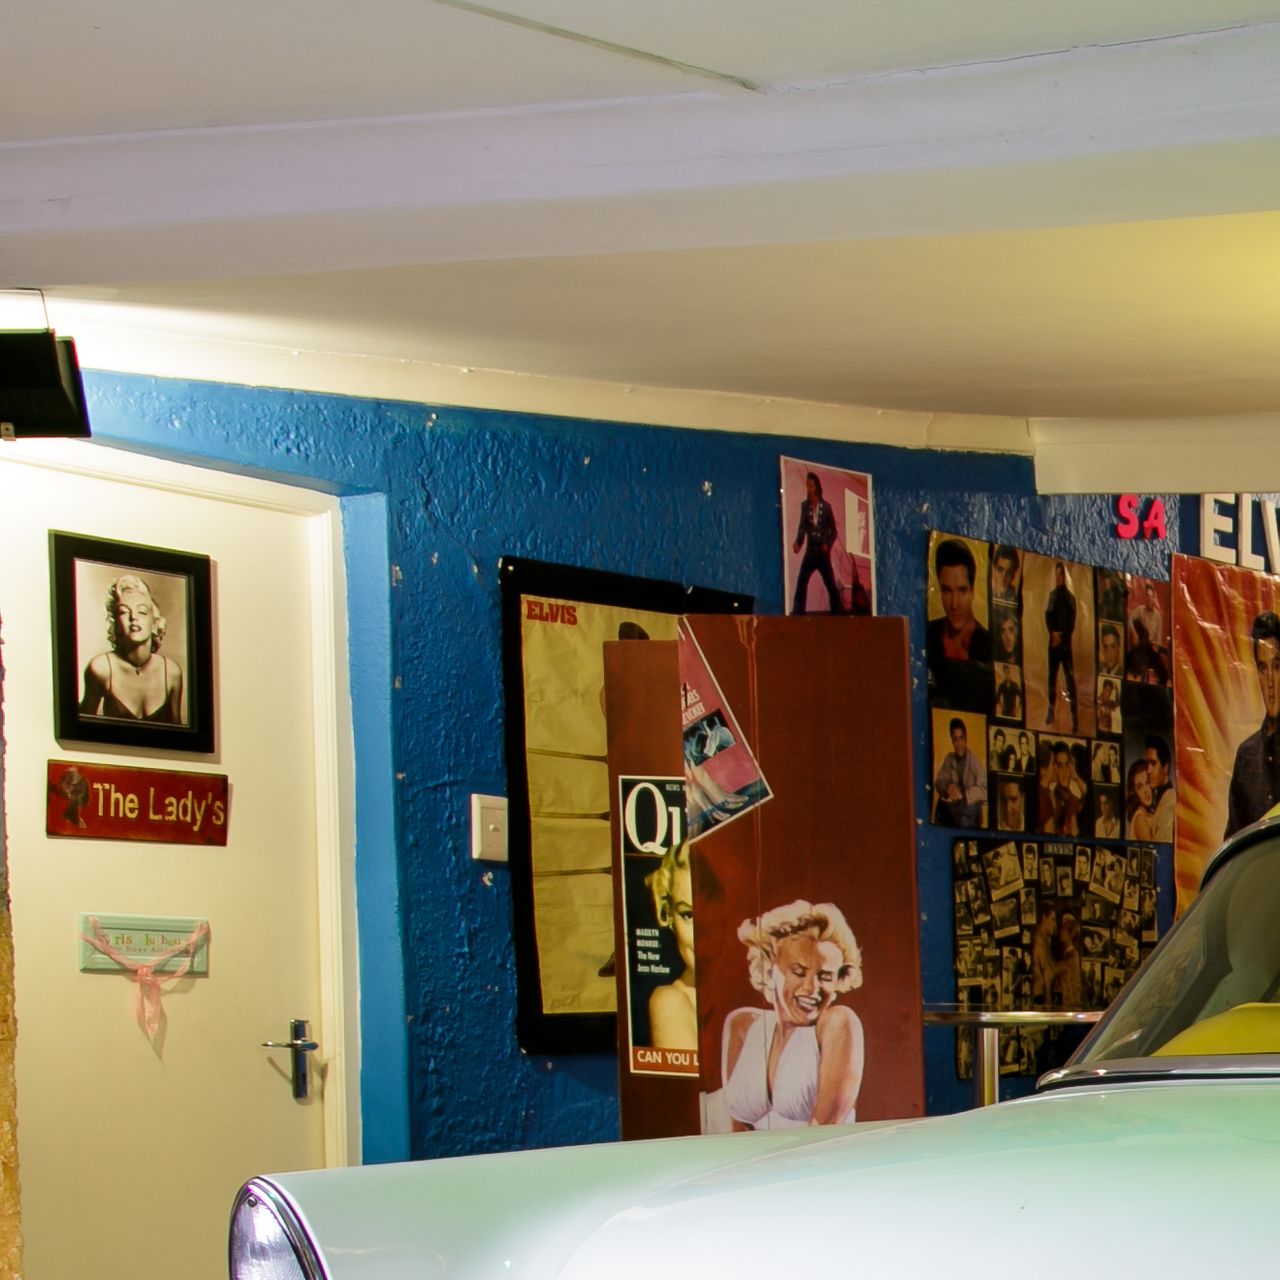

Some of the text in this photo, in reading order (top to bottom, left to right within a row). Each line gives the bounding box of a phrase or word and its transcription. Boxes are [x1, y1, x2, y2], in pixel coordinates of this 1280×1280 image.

[526, 600, 578, 626] ELVIS
[93, 783, 225, 832] The Lady's
[637, 1050, 662, 1063] CAN
[665, 1052, 690, 1066] YOU
